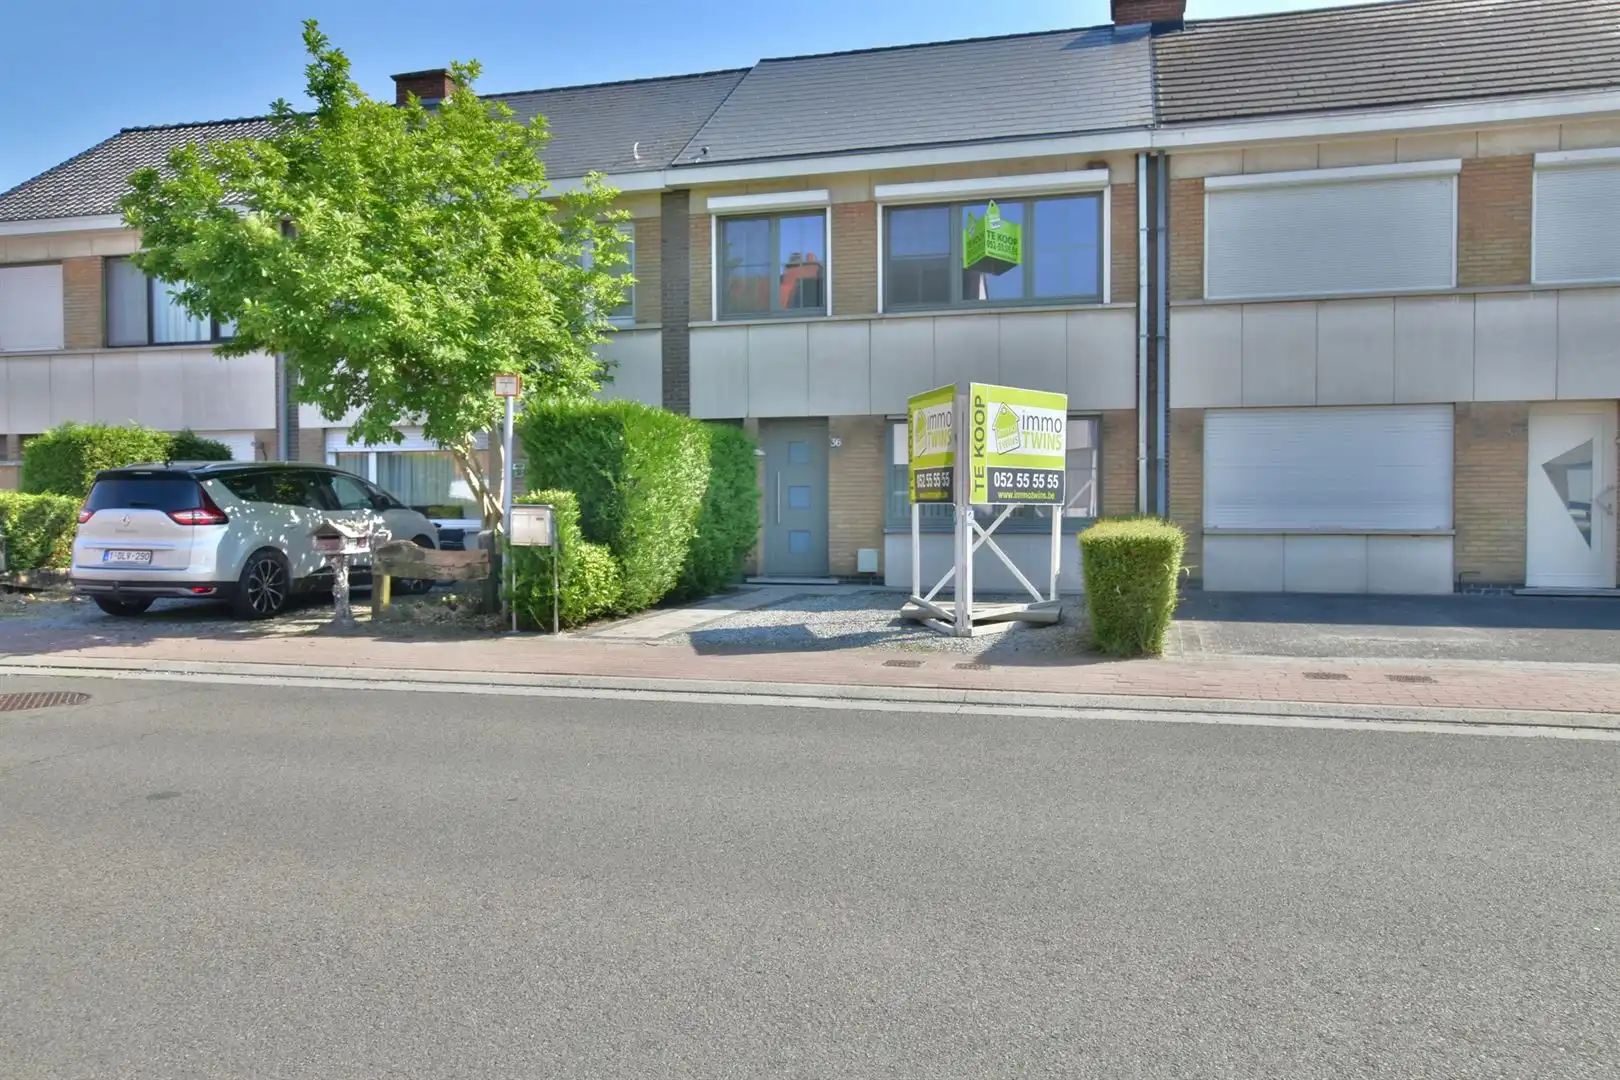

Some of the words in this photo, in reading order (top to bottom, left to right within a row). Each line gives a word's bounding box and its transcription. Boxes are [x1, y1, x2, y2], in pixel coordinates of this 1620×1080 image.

[927, 411, 952, 430] immo
[974, 395, 985, 458] KOOP
[1022, 409, 1062, 433] immo
[1024, 431, 1062, 450] TWINS
[974, 466, 985, 492] TE
[994, 472, 1013, 488] 052
[1016, 473, 1030, 488] 55
[1032, 474, 1045, 488] 55
[1047, 474, 1059, 489] 55
[997, 491, 1056, 500] www.immotwins.be
